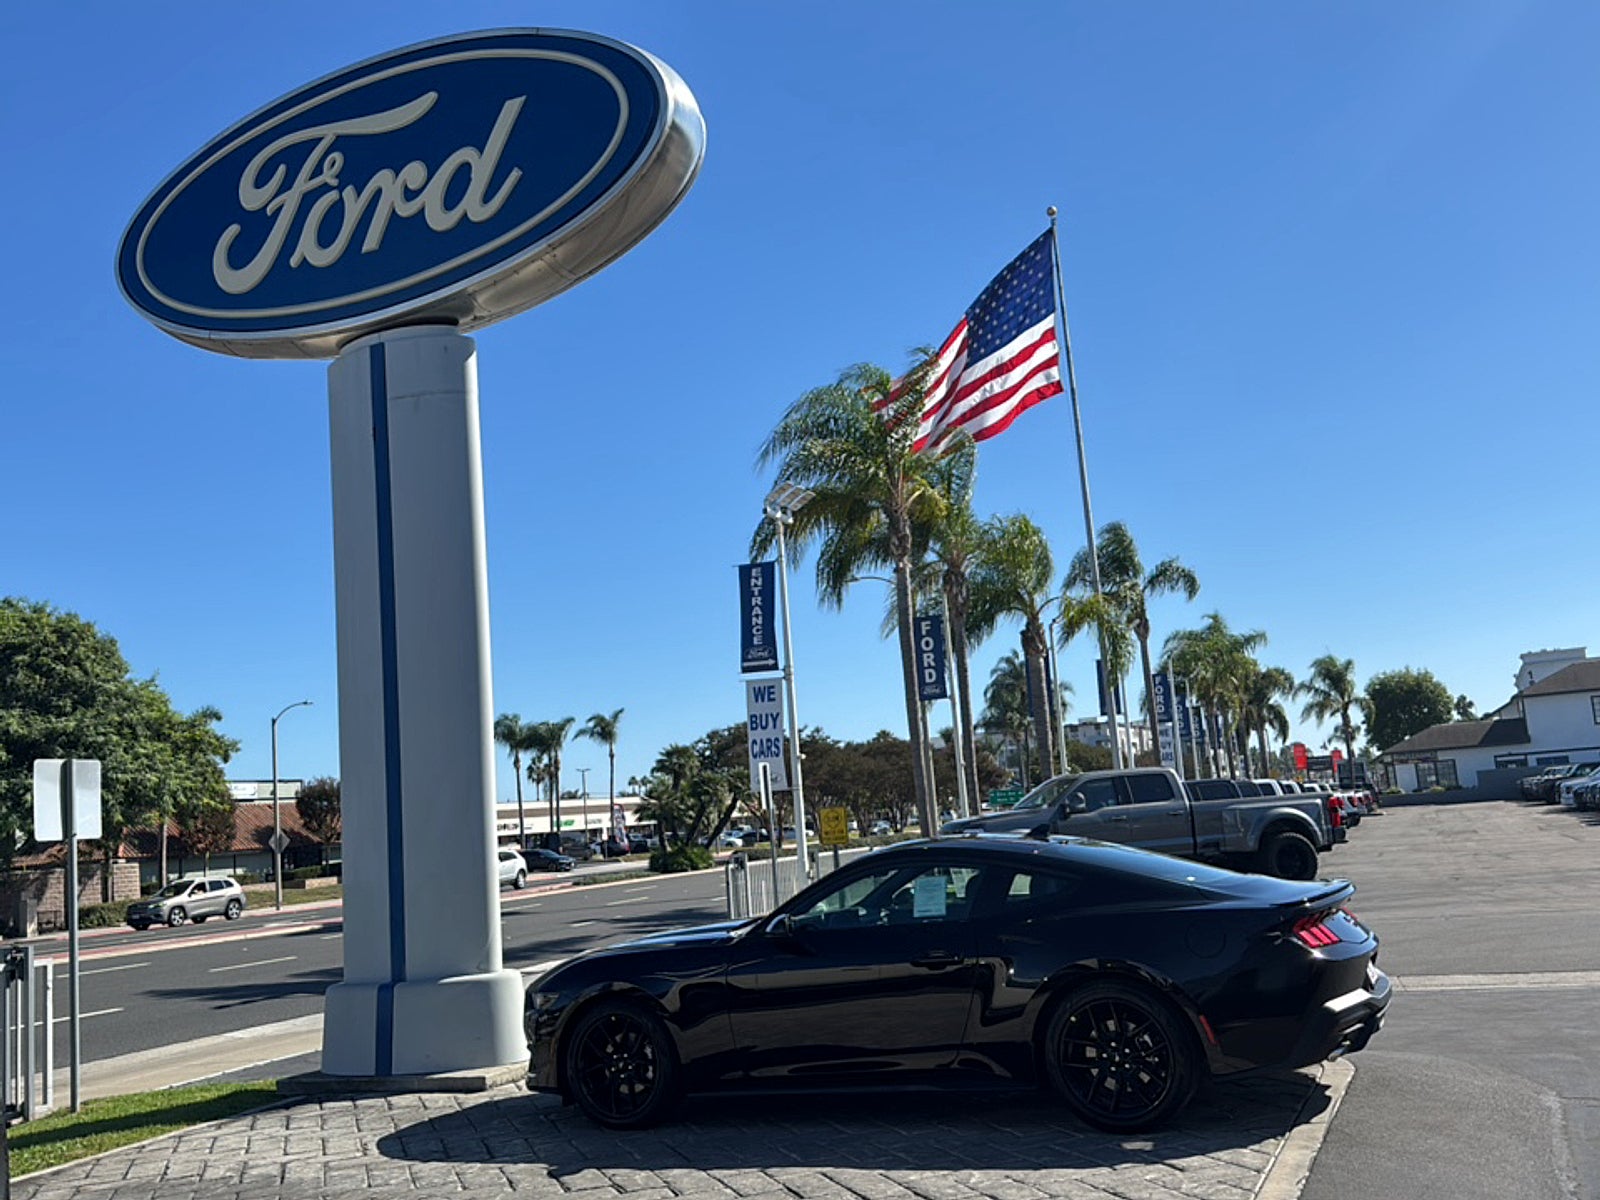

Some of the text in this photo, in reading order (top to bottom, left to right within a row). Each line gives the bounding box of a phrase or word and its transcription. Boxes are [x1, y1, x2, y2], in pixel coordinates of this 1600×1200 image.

[212, 90, 526, 294] Ford
[751, 567, 763, 645] ENTRANCE
[920, 620, 937, 684] FORD
[753, 685, 776, 703] WE
[750, 712, 780, 731] BUY
[751, 737, 780, 759] CARS
